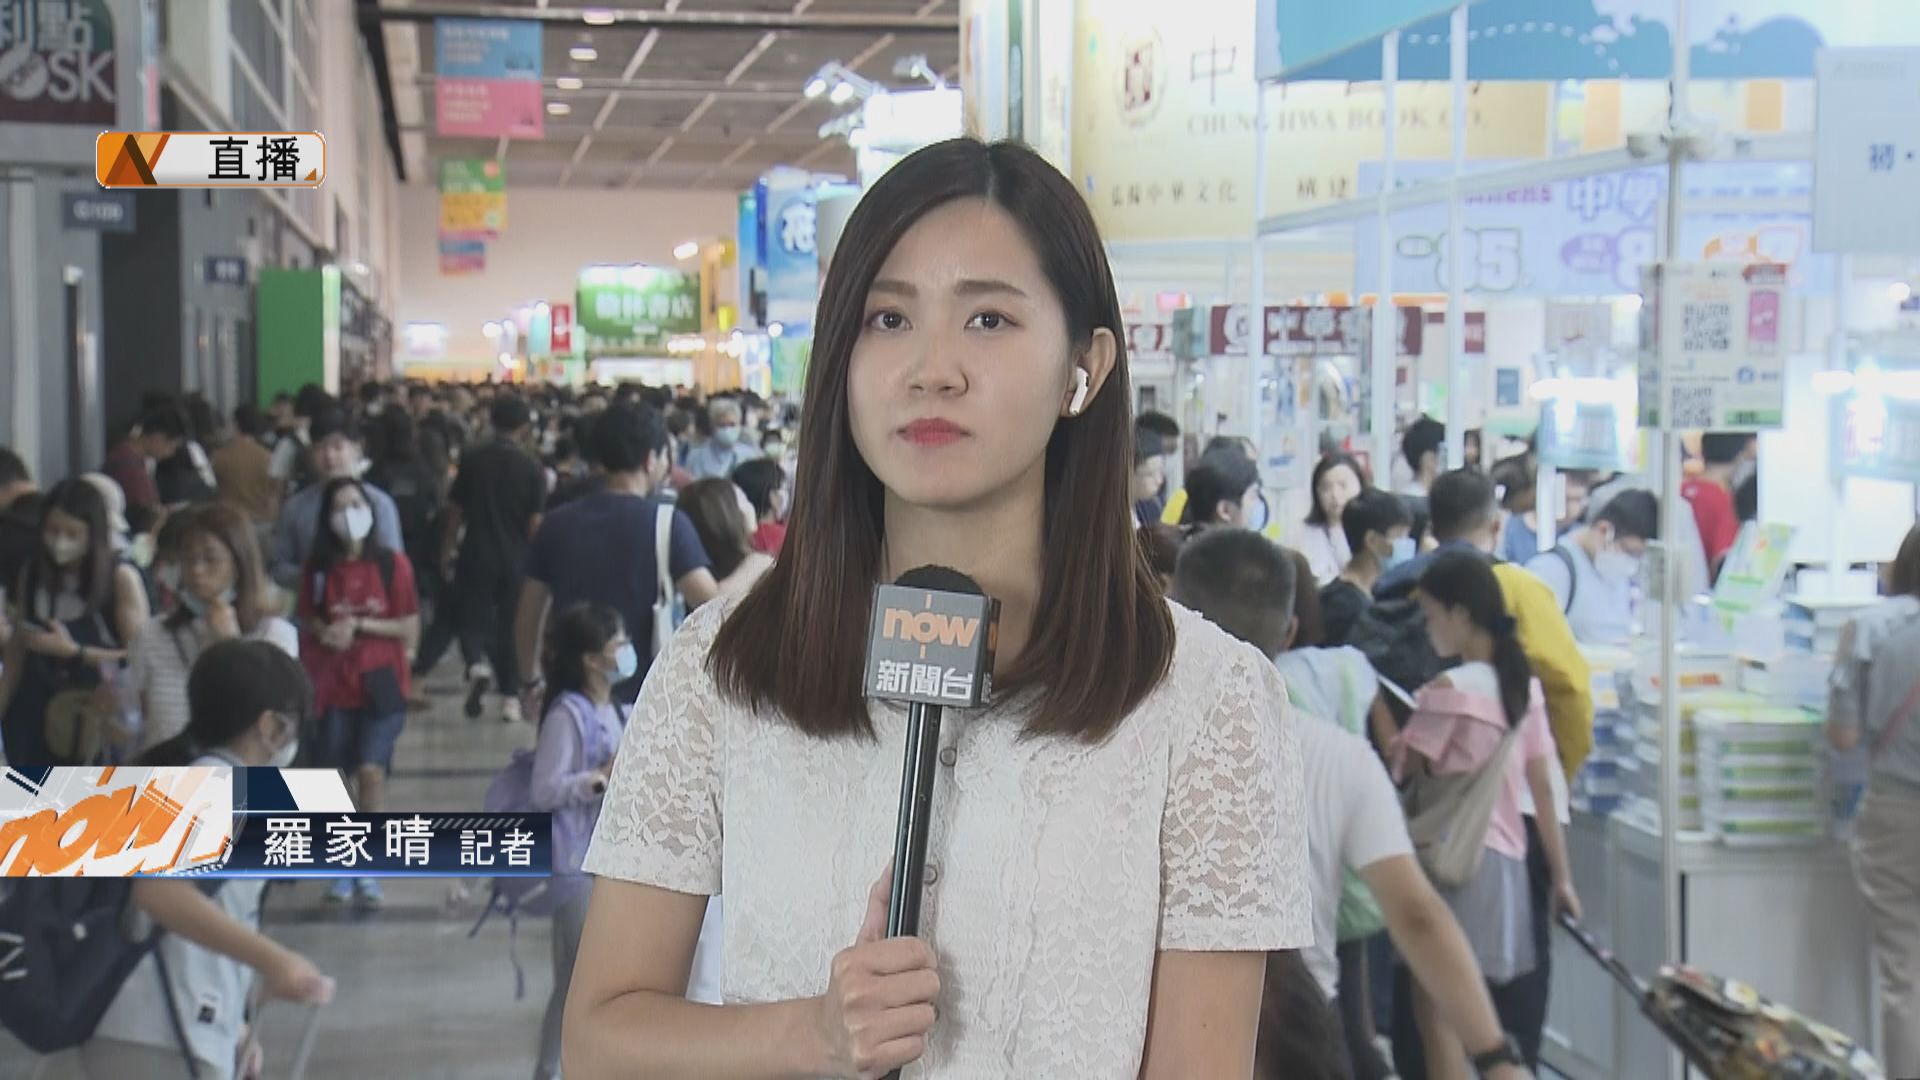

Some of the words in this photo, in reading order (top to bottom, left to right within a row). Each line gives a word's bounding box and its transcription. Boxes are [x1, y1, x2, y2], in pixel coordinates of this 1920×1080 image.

[882, 608, 979, 648] now
[876, 660, 973, 700] 新聞台
